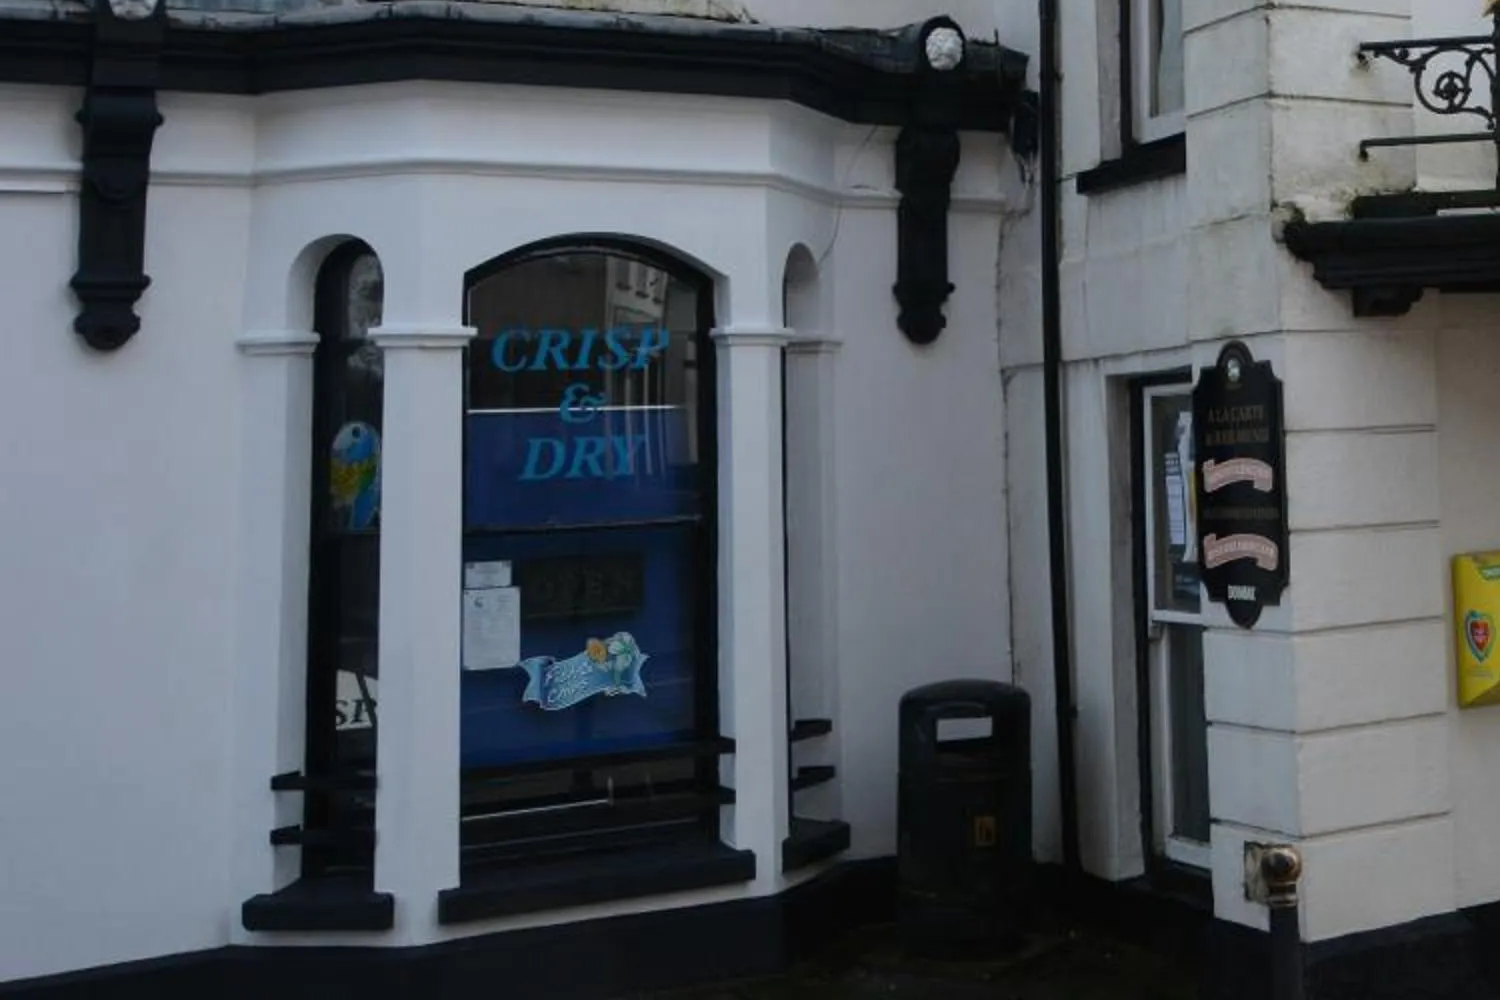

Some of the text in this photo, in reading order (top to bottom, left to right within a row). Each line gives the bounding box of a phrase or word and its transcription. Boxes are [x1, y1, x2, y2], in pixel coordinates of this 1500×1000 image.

[490, 326, 670, 373] CRISP
[559, 382, 608, 424] &
[516, 435, 645, 482] DRY
